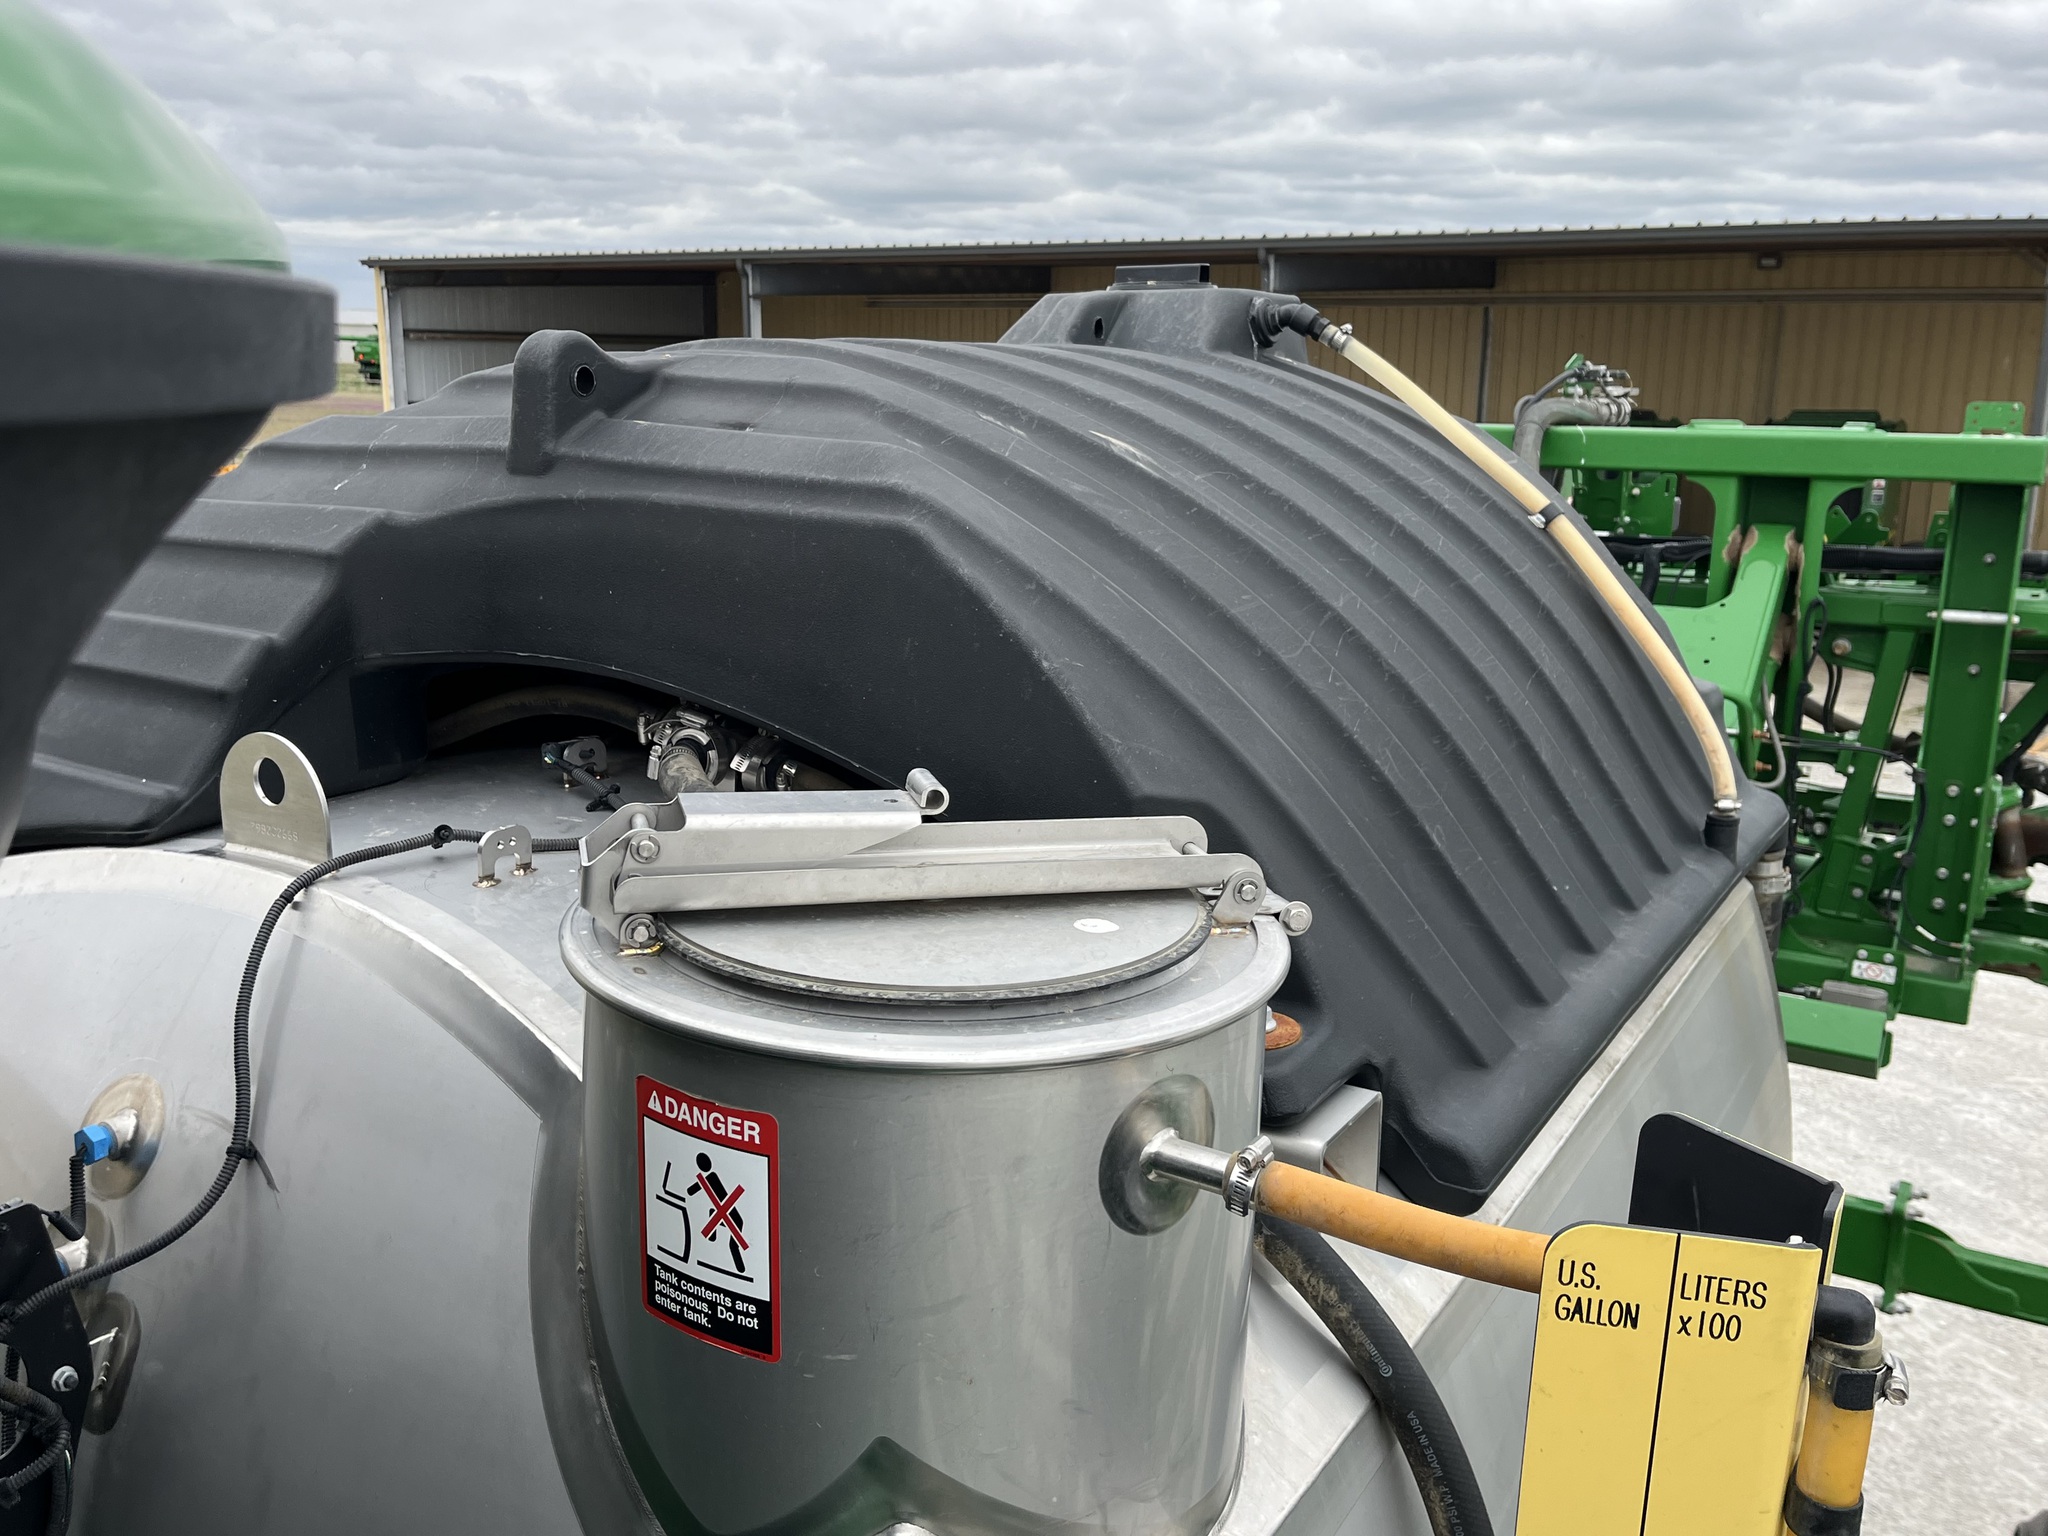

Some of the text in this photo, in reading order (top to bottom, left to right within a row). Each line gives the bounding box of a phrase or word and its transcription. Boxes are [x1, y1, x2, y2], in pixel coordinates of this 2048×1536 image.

[664, 1096, 761, 1145] DANGER
[654, 1263, 757, 1314] Tank contents are
[1558, 1259, 1601, 1290] U.S.
[1680, 1273, 1768, 1310] LITERS
[655, 1280, 759, 1330] poisonous. Do not
[655, 1294, 712, 1328] enter tank.
[1554, 1294, 1640, 1329] GALLON
[1677, 1311, 1742, 1342] x100
[1354, 1327, 1393, 1377] Continental
[1407, 1410, 1423, 1434] USA
[1418, 1434, 1430, 1446] IN
[1424, 1446, 1444, 1478] MADE
[1446, 1506, 1461, 1524] PSI
